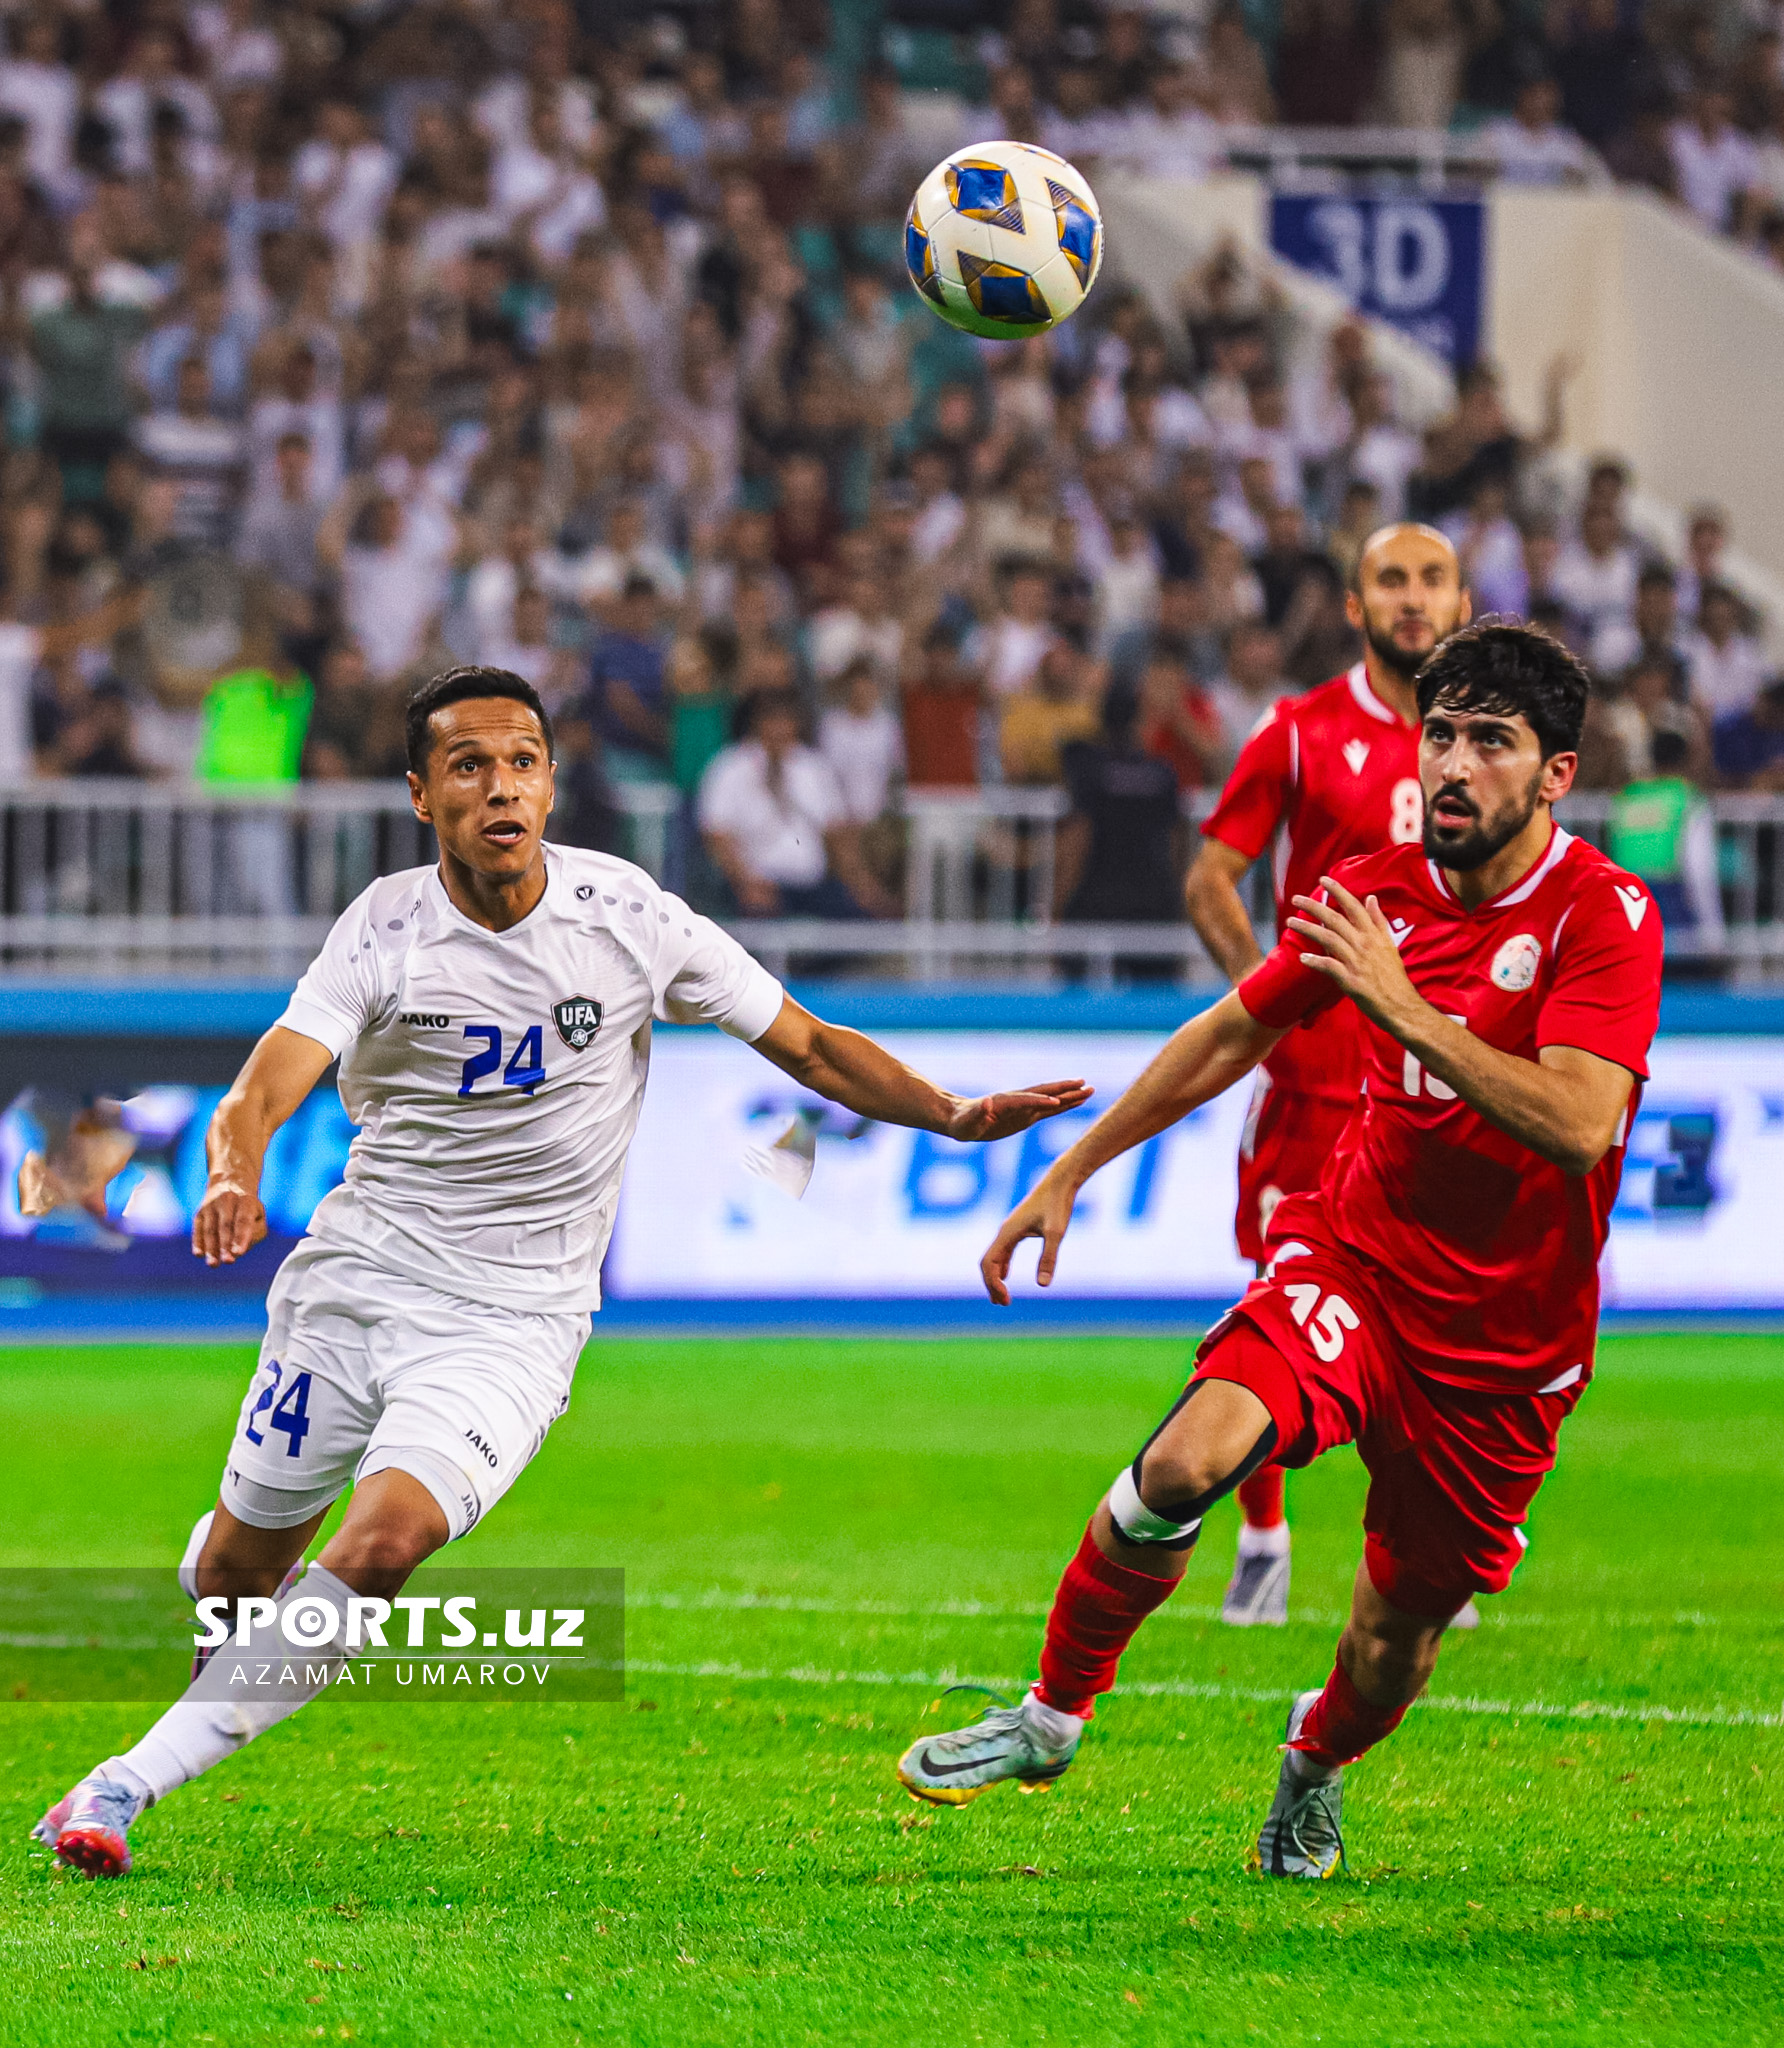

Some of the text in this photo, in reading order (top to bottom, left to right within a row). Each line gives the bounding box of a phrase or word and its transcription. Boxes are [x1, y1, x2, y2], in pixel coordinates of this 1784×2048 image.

[1390, 778, 1422, 844] 8
[399, 1014, 450, 1028] JAKO
[561, 1006, 597, 1026] UFA
[458, 1025, 546, 1098] 24
[1284, 1284, 1360, 1362] 15
[246, 1359, 312, 1458] 24
[462, 1428, 498, 1468] JAKO
